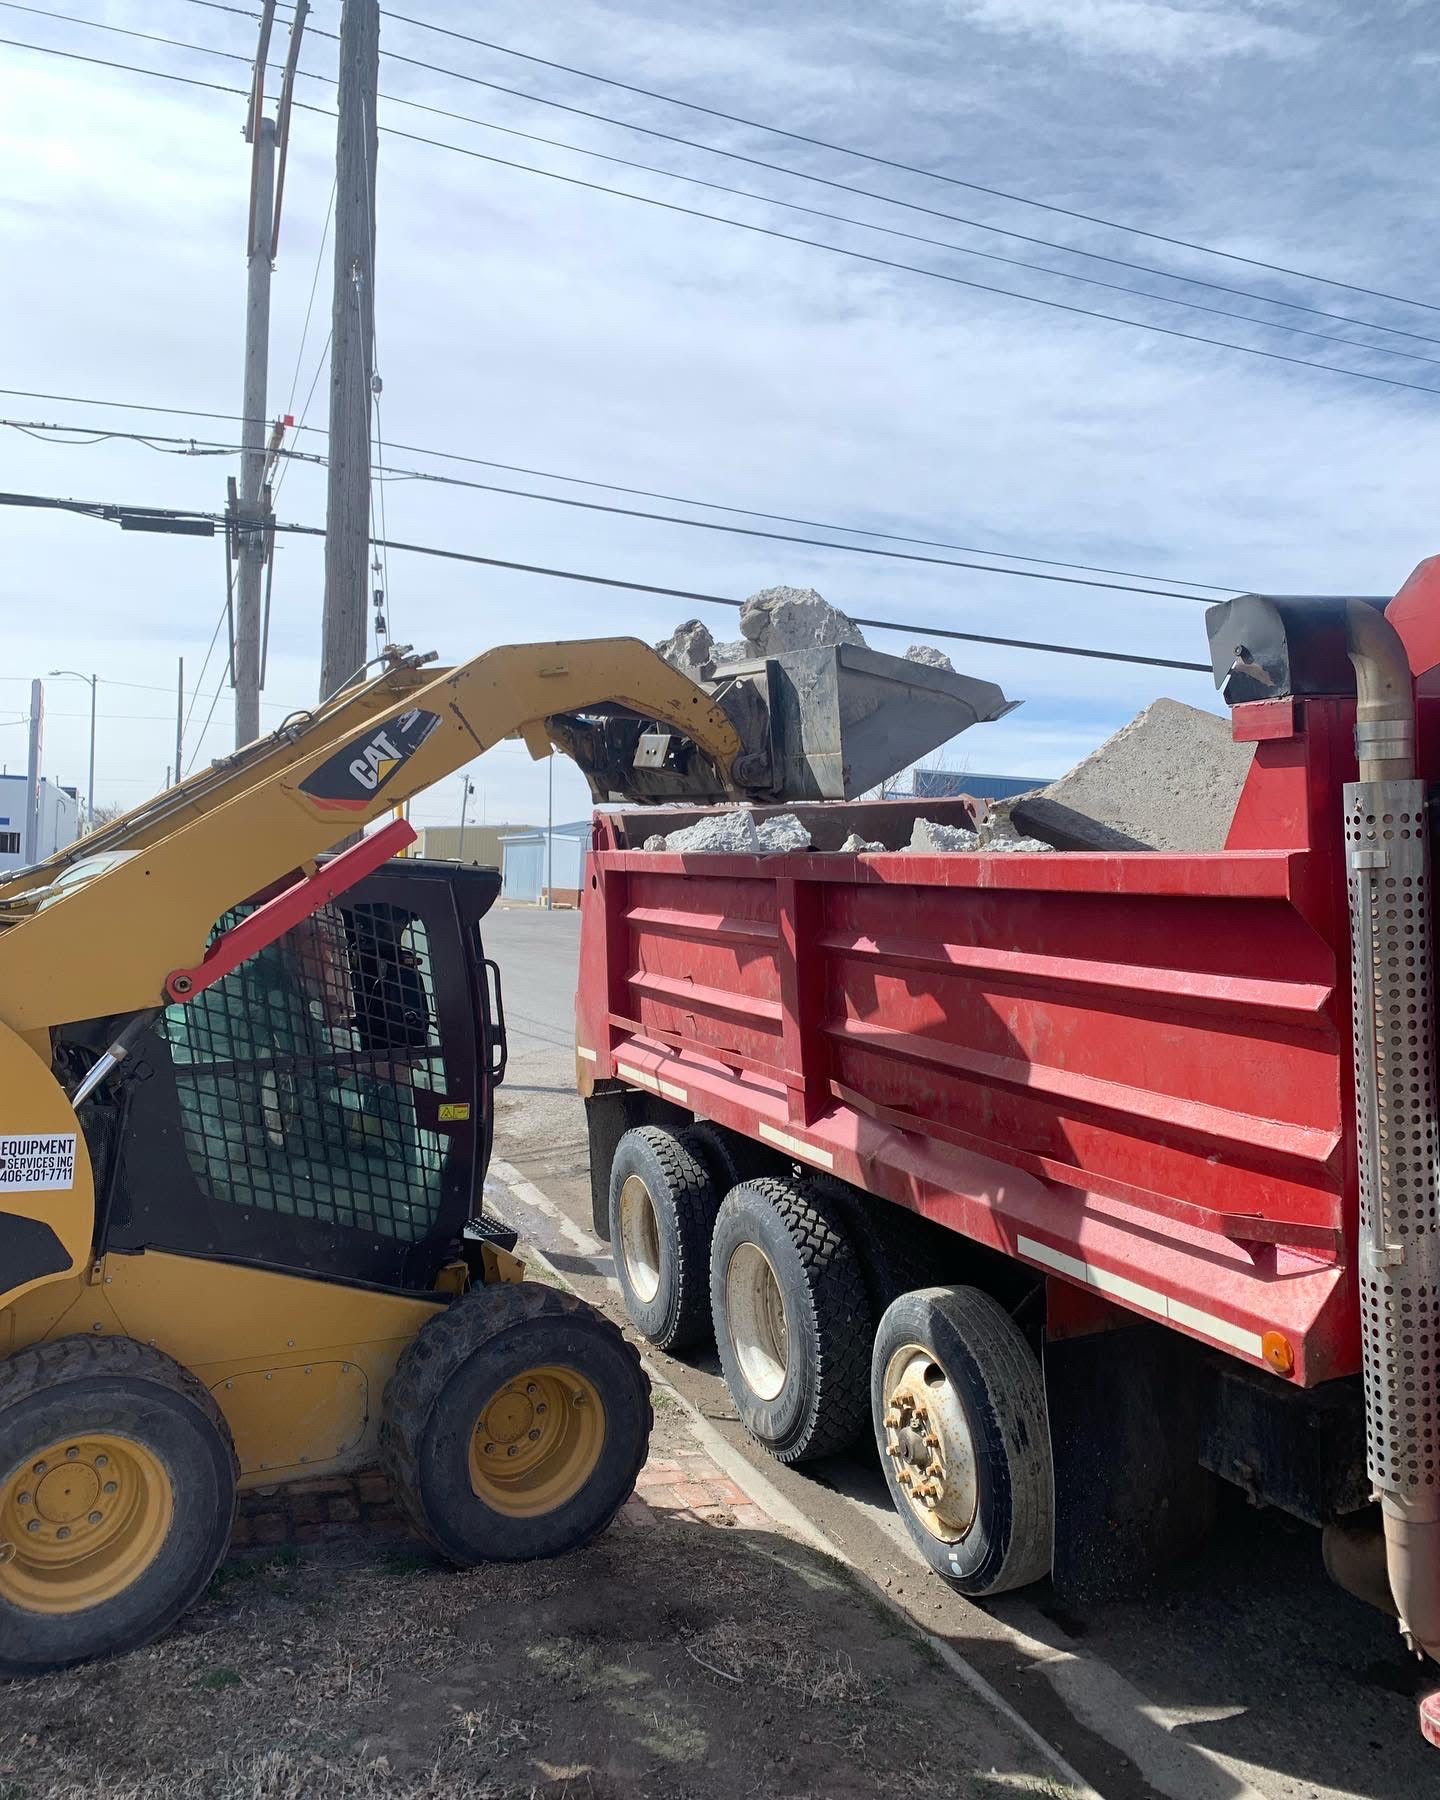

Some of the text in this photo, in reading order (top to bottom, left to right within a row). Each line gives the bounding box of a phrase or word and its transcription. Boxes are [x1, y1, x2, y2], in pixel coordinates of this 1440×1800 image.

[349, 730, 403, 790] CAT
[1, 1139, 75, 1157] EQUIPMENT
[7, 1156, 73, 1169] SERVICES INC
[0, 1168, 73, 1182] 406-201-7711
